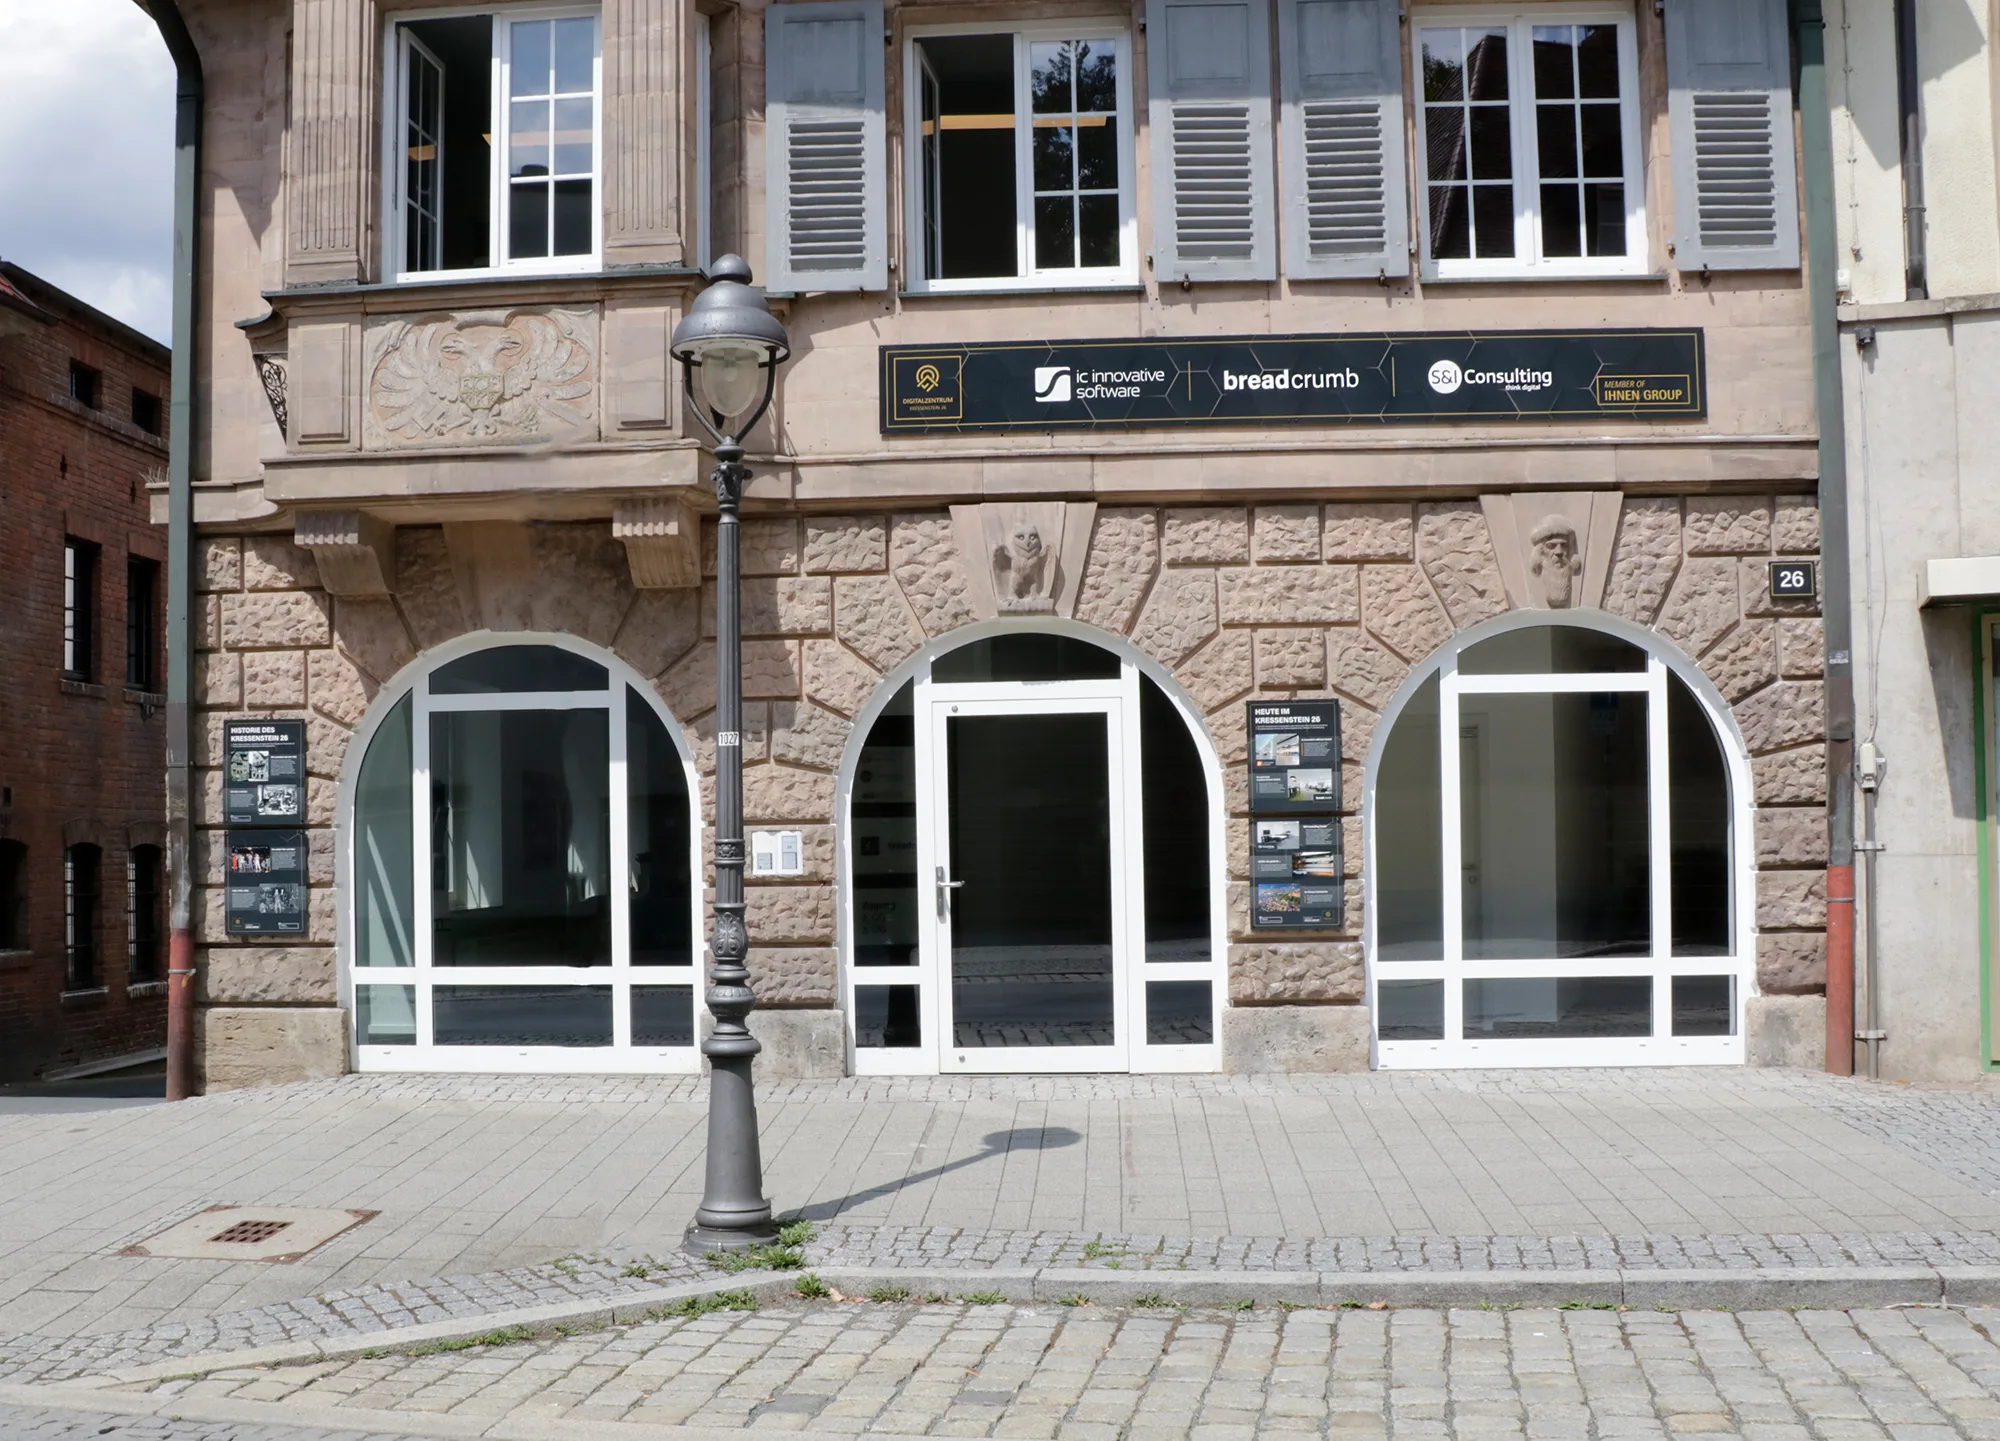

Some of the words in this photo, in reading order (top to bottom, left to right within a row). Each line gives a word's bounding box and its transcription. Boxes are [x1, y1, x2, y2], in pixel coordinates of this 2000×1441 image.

[1076, 369, 1088, 383] ic
[1092, 367, 1165, 383] innovative
[1223, 367, 1359, 390] breadcrumb
[1431, 369, 1458, 384] S&I
[1463, 367, 1553, 387] Consulting
[1521, 384, 1541, 392] digital
[1604, 380, 1635, 388] MEMBER
[1636, 380, 1646, 388] OF
[1076, 384, 1140, 398] software
[1604, 389, 1640, 401] IHNEN
[1643, 389, 1683, 400] GROUP
[902, 396, 954, 404] DIGITALZENTRUM
[1780, 571, 1804, 587] 26
[1255, 716, 1310, 724] KRESSENSTEIN
[720, 733, 738, 744] 1027
